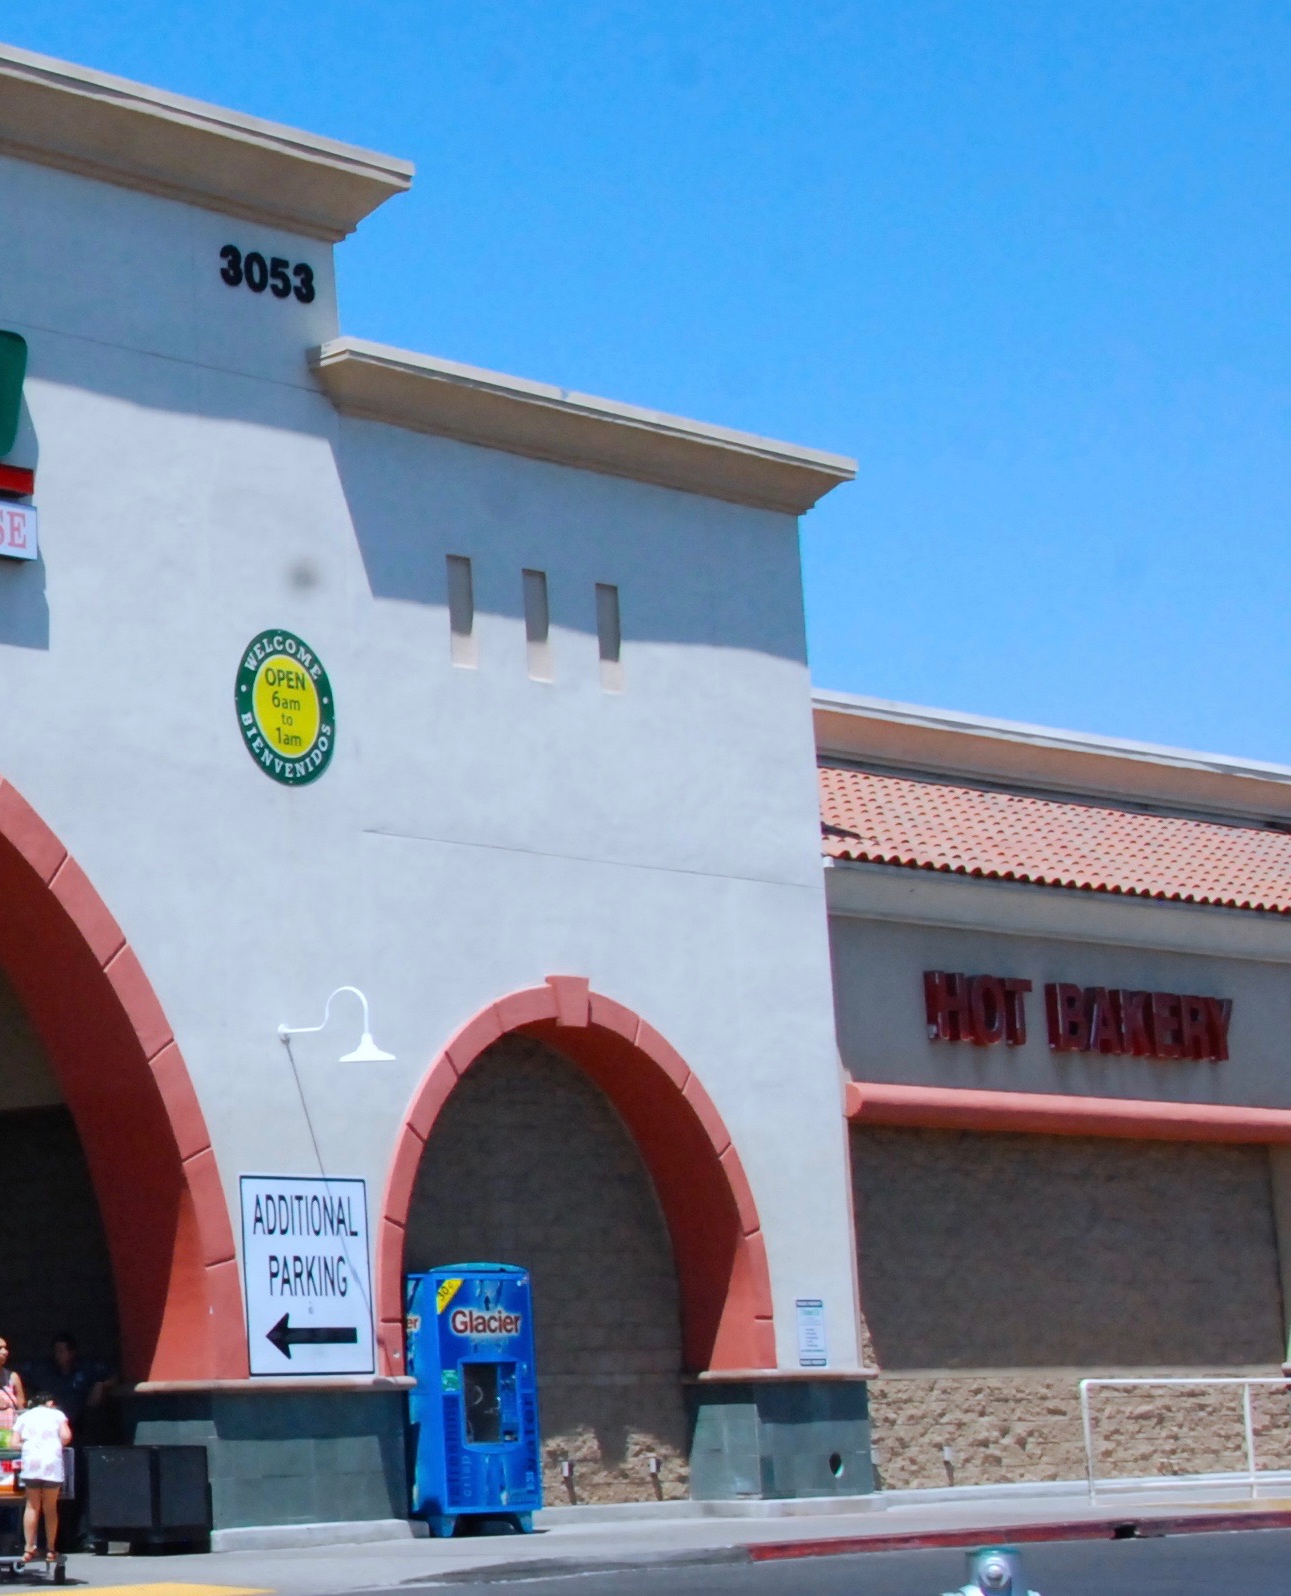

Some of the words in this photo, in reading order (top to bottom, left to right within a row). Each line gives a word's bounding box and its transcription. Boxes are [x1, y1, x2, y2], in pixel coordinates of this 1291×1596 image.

[220, 244, 315, 303] 3053
[245, 636, 322, 680] WELCOME
[265, 668, 306, 690] OPEN
[272, 691, 301, 710] 6am
[281, 714, 293, 726] to
[241, 712, 331, 777] BIENVENIDOS
[276, 727, 302, 746] 1am
[923, 970, 1032, 1046] HOT
[1044, 983, 1233, 1060] BAKERY
[253, 1194, 358, 1237] ADDITIONAL
[269, 1255, 347, 1297] PARKING
[452, 1309, 520, 1334] Glacier
